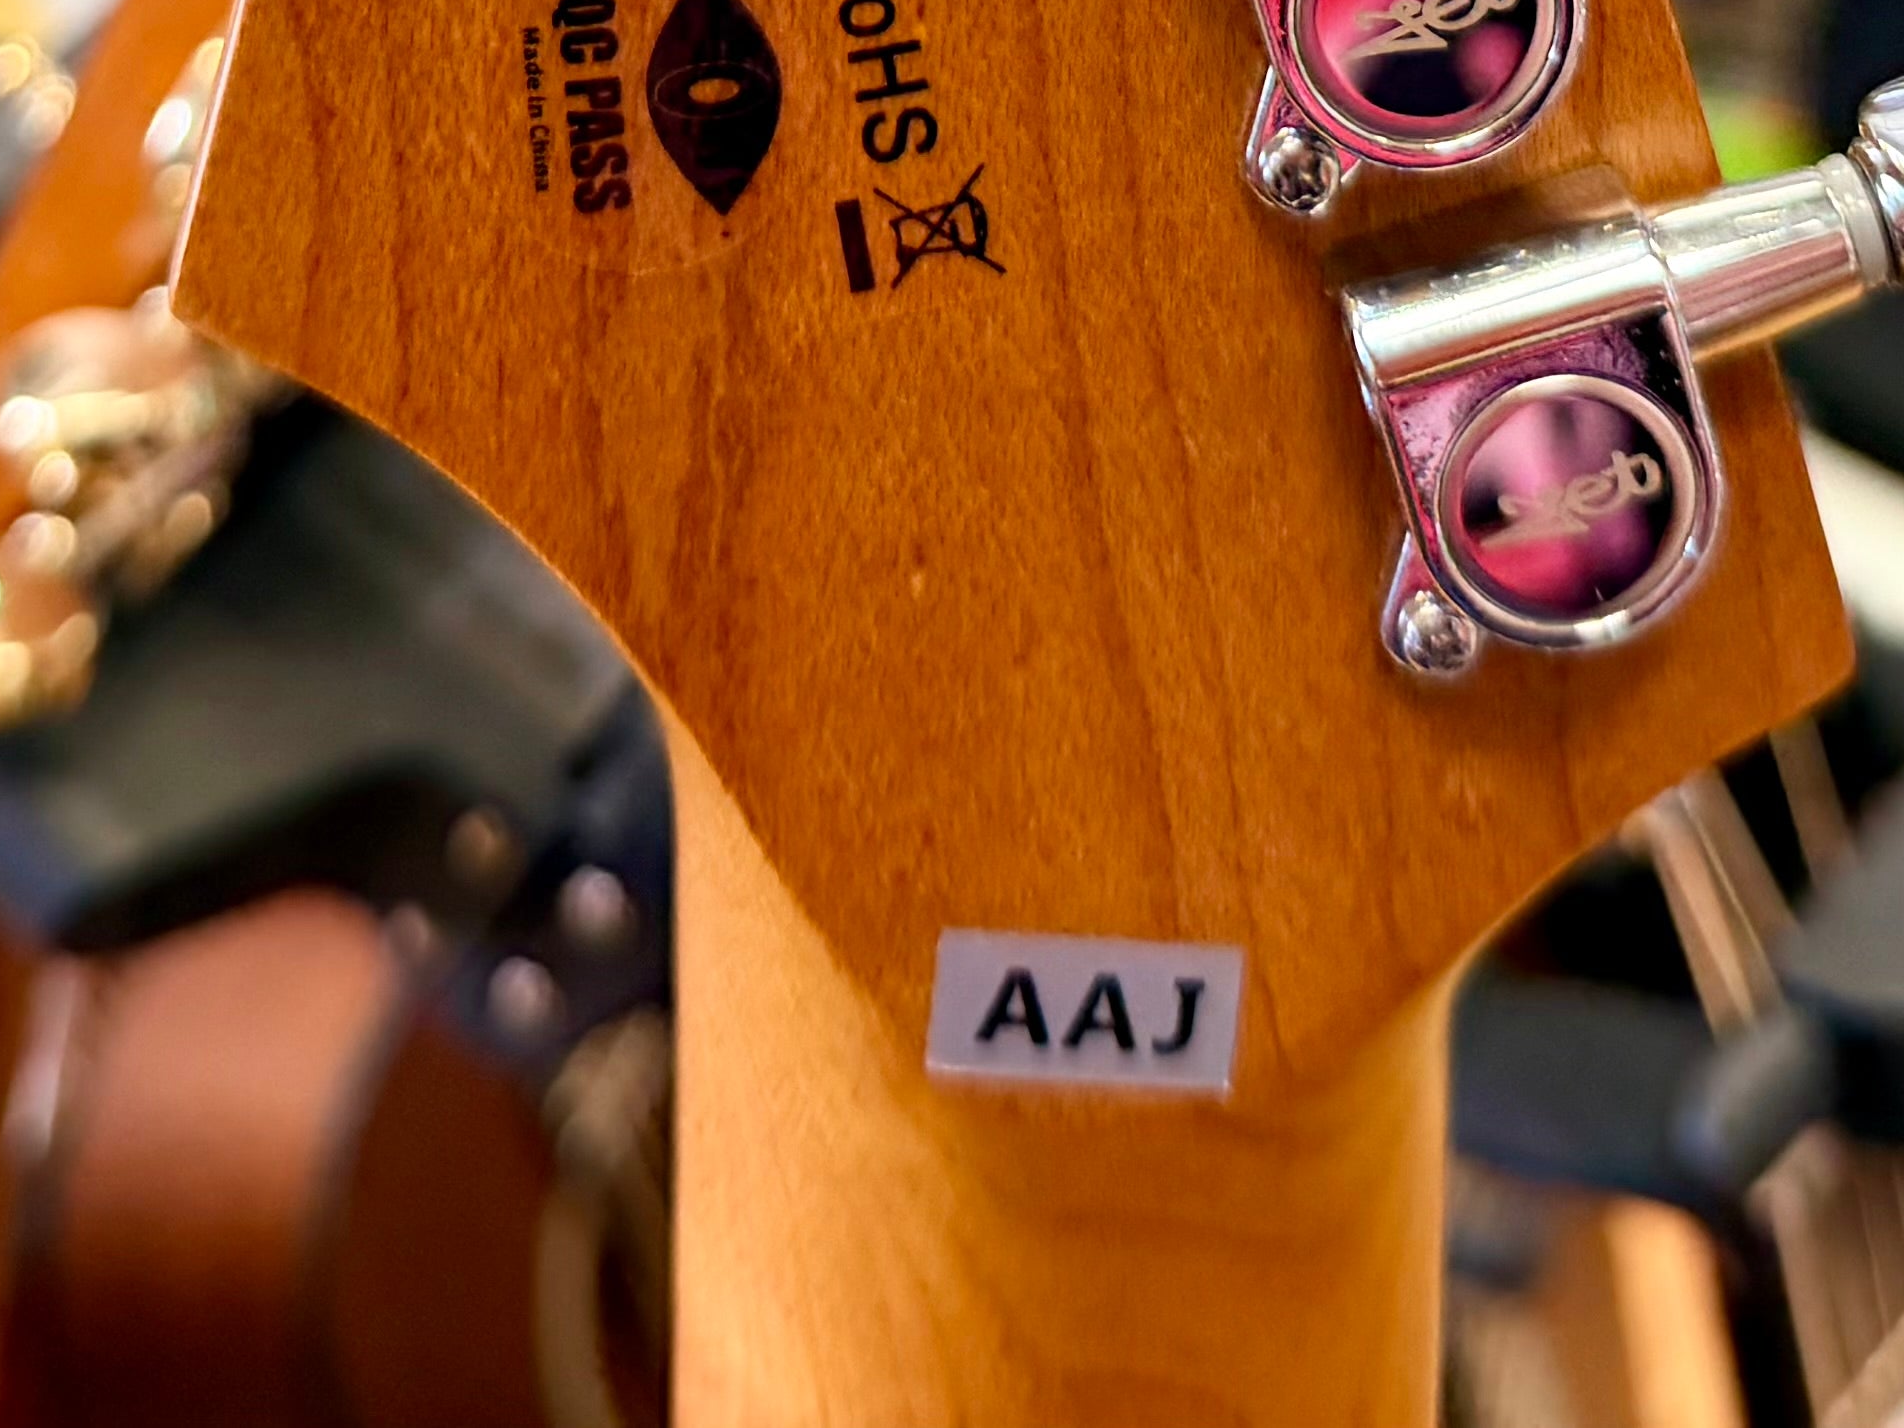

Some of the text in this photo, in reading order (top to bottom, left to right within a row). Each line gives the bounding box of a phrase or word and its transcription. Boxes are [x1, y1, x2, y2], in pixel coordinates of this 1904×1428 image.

[522, 26, 544, 90] Made
[529, 124, 551, 193] China
[564, 75, 633, 214] PASS
[973, 965, 1206, 1055] AAJ
